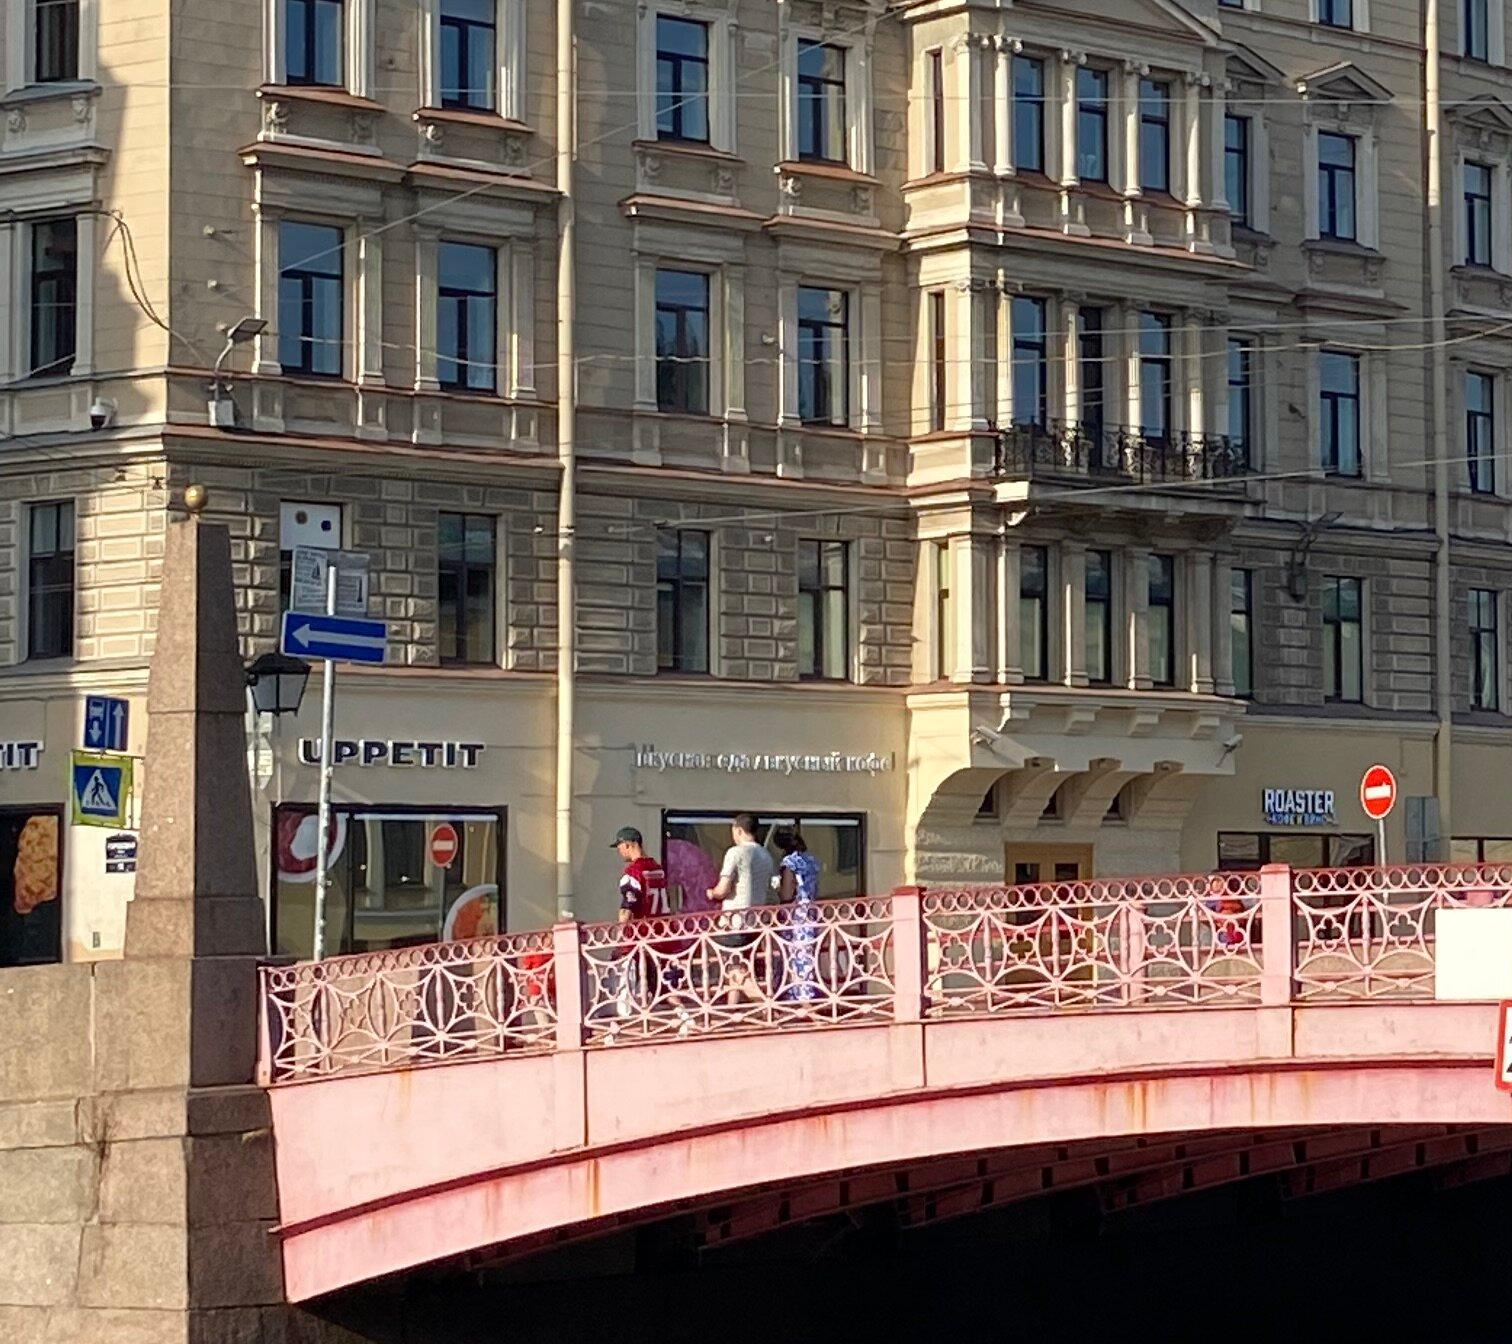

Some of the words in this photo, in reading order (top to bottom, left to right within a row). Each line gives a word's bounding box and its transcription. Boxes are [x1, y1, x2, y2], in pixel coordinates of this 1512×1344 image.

[0, 741, 44, 768] IT
[298, 738, 486, 768] UPPETIT
[1262, 788, 1334, 813] ROASTER
